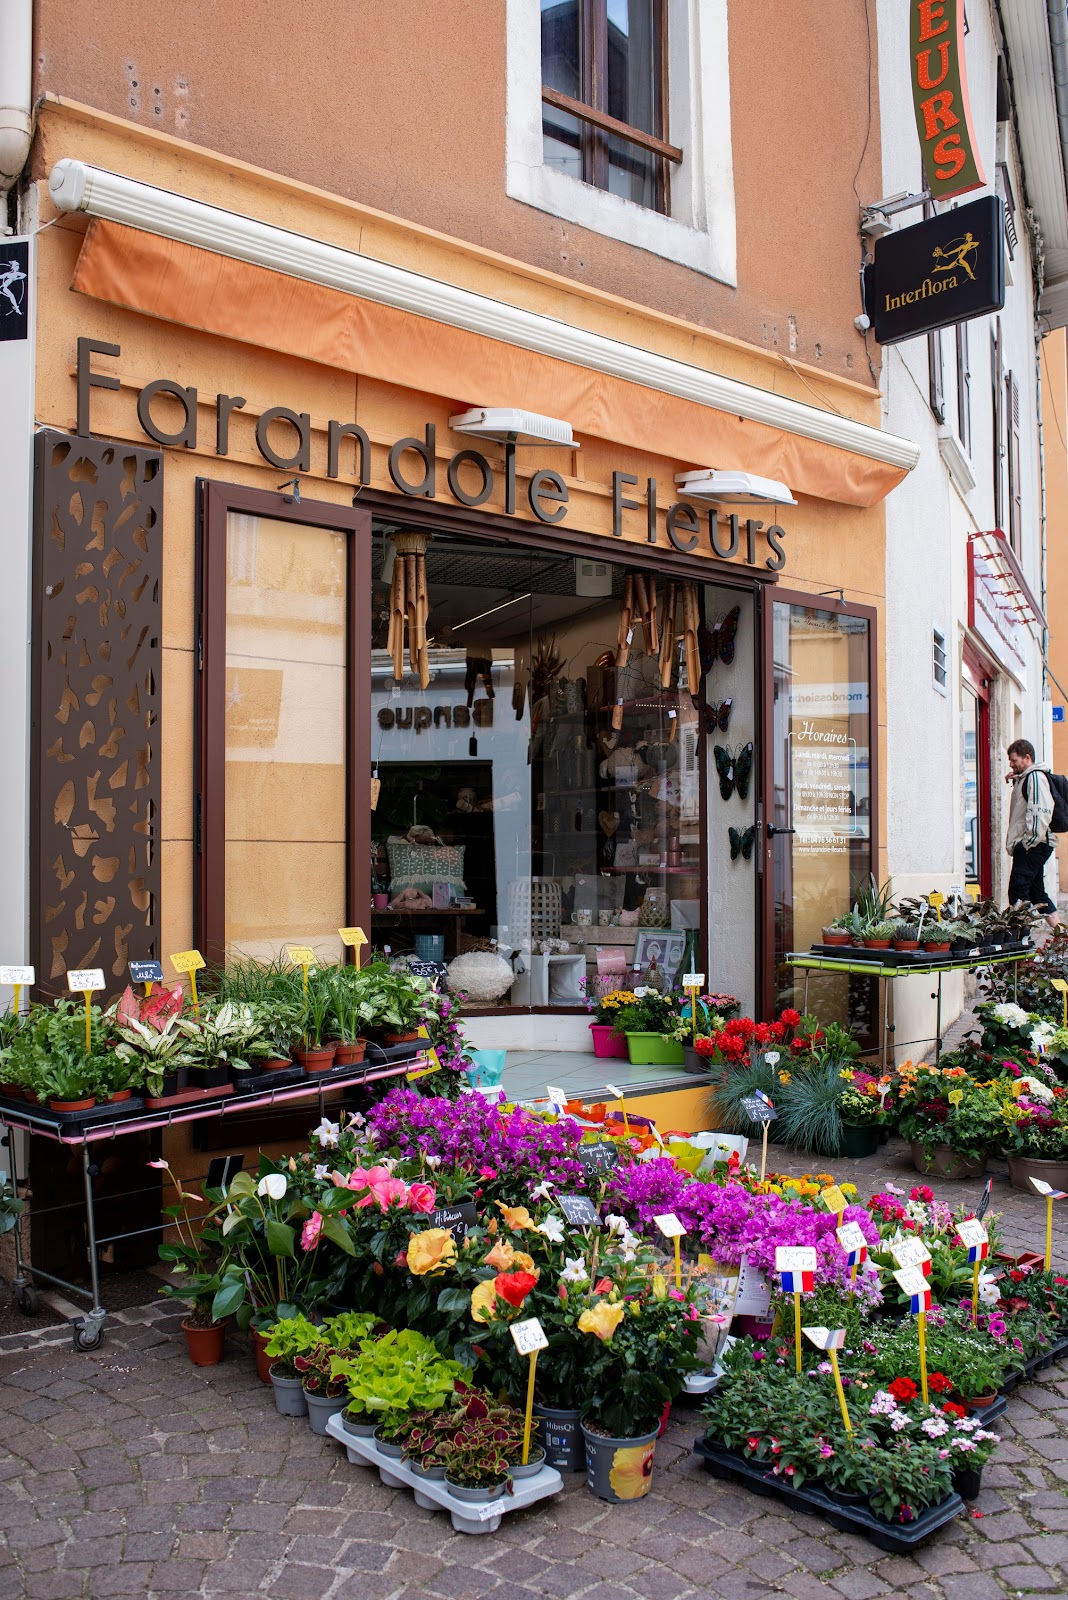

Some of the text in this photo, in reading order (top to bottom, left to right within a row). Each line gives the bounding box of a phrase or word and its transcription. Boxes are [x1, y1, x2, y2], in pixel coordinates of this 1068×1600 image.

[884, 275, 959, 313] Interflora
[76, 336, 787, 572] Farandole Fleurs
[797, 720, 848, 744] Horaires
[834, 784, 852, 792] samedi
[793, 804, 820, 812] Dimanche
[825, 805, 838, 814] jours
[840, 836, 846, 844] 31
[434, 1210, 463, 1227] Hibiscus
